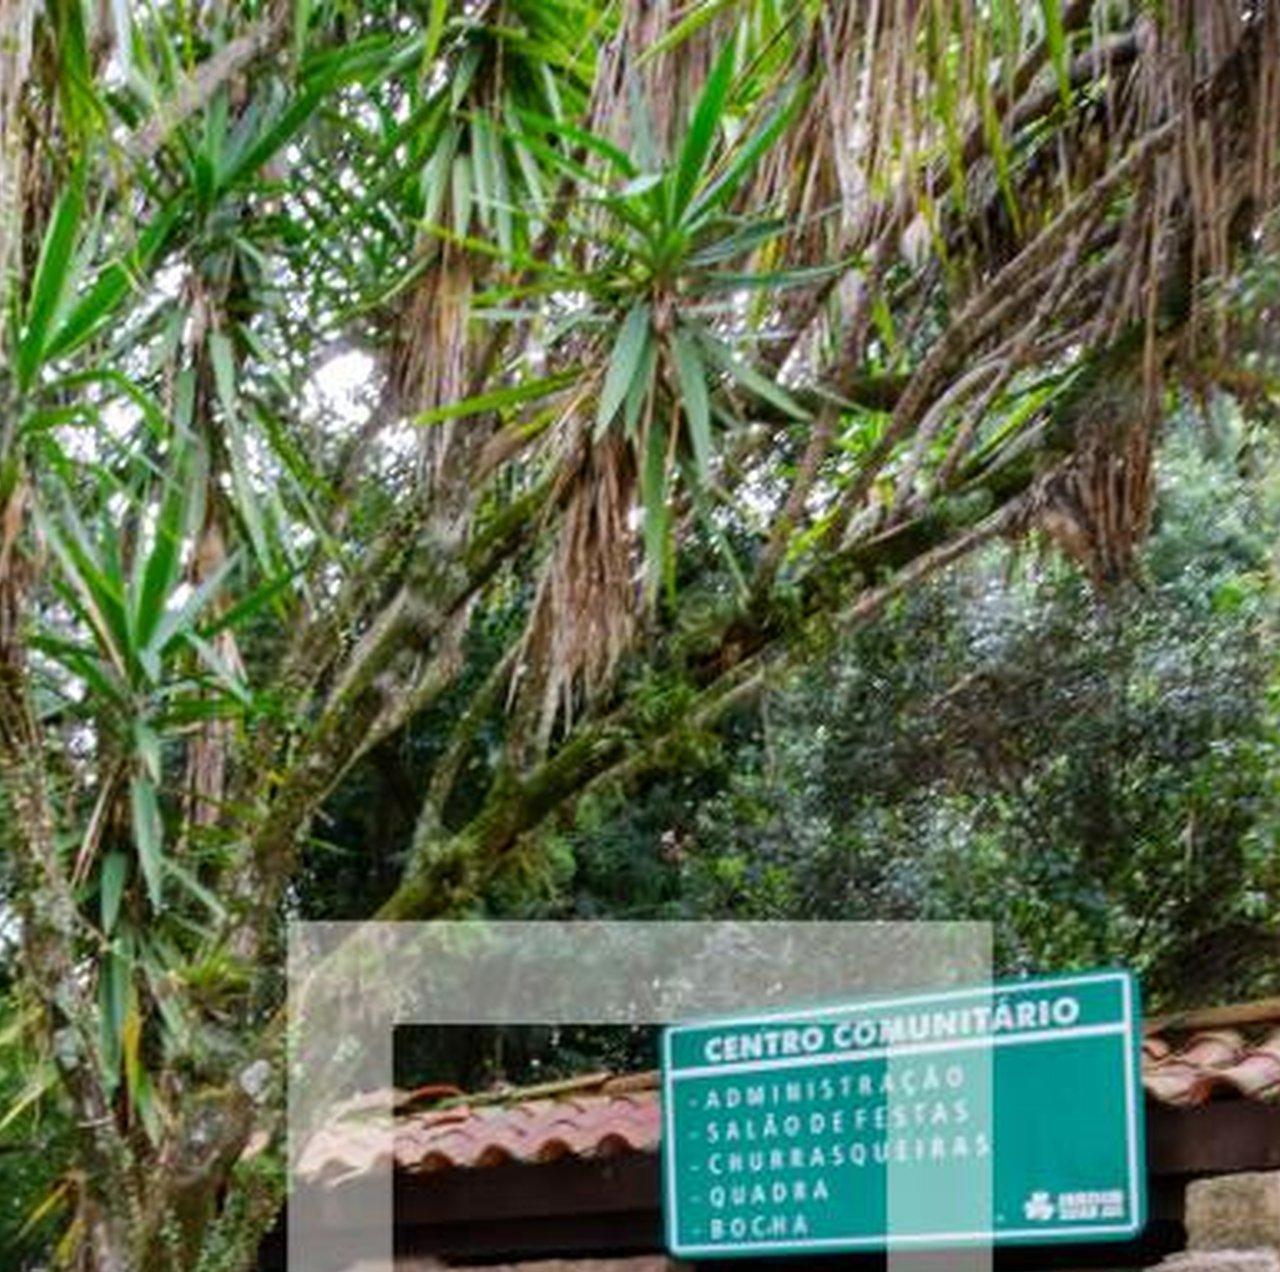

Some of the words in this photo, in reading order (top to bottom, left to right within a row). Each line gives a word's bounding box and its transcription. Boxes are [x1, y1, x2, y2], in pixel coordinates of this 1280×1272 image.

[704, 1025, 825, 1062] CENTRO
[832, 996, 1081, 1049] COMUNITÁRIO
[705, 1064, 964, 1109] ADMINISTRAÇÃO
[706, 1111, 801, 1144] SALÃO
[808, 1108, 844, 1135] DE
[854, 1100, 970, 1131] FESTAS
[707, 1133, 991, 1175] CHURRASQUEIRAS
[709, 1178, 829, 1208] QUADRA
[709, 1213, 810, 1241] BOCHA
